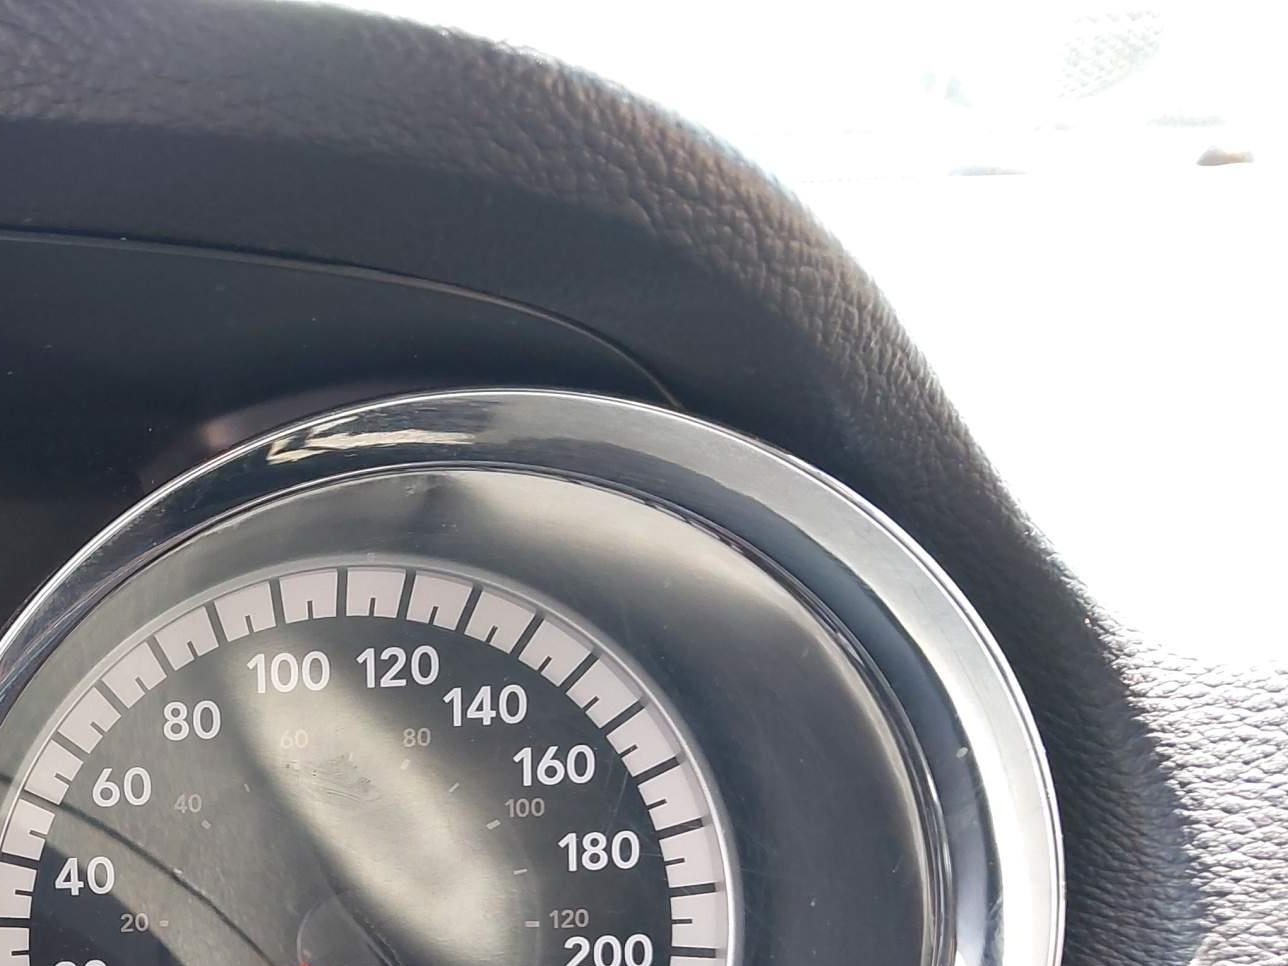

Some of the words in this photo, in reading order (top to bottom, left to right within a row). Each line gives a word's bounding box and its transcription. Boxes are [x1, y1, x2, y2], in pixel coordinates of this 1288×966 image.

[247, 651, 330, 692] 100
[356, 645, 440, 688] 120
[163, 701, 221, 740] 80
[443, 685, 528, 727] 140
[279, 730, 309, 749] 60
[403, 728, 432, 748] 80
[512, 745, 596, 785] 160
[91, 767, 152, 807] 60
[174, 794, 203, 814] 40
[506, 798, 546, 818] 100
[557, 830, 641, 871] 180
[55, 856, 115, 896] 40
[120, 913, 150, 933] 20
[549, 910, 590, 929] 120
